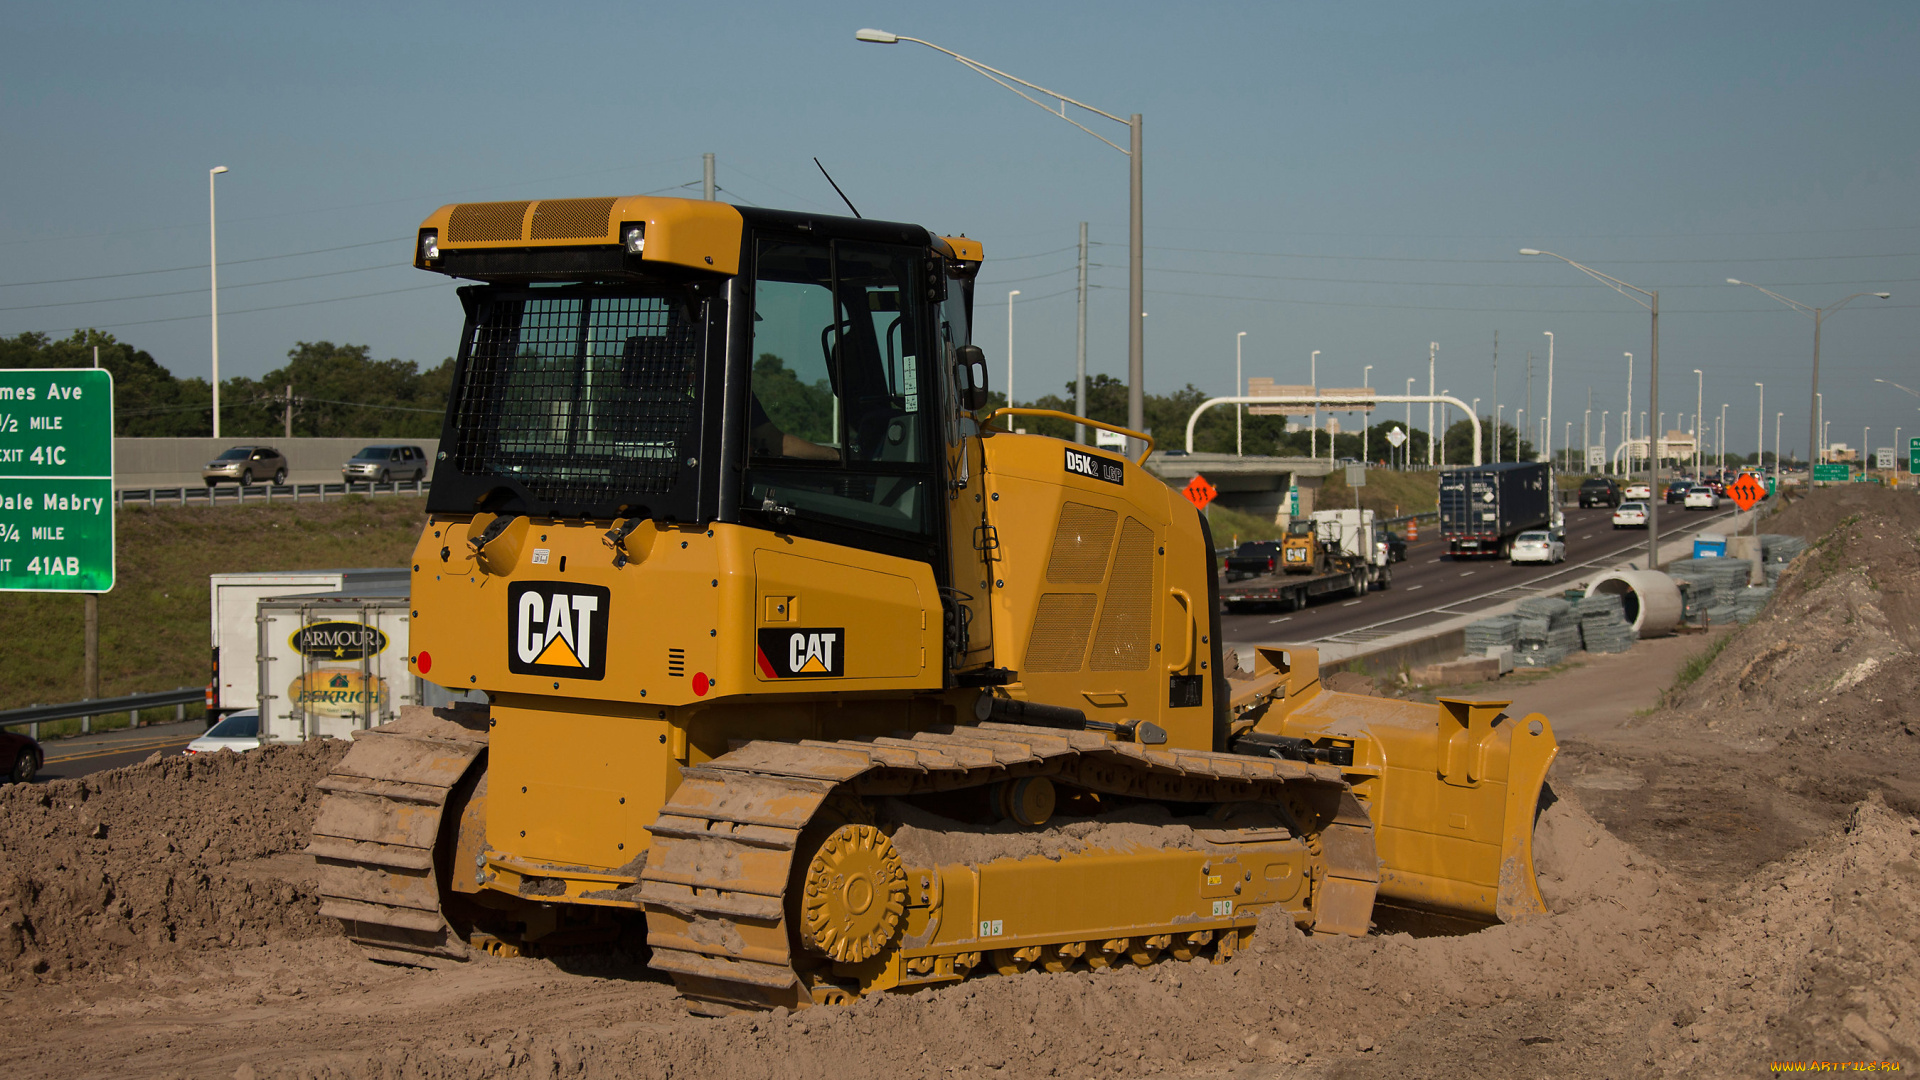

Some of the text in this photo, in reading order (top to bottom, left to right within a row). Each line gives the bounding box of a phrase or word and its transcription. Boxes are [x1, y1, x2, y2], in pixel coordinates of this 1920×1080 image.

[47, 383, 82, 400] Ave
[30, 416, 63, 430] MILE
[30, 446, 66, 466] 41C
[44, 493, 103, 515] Mabry
[0, 523, 65, 543] 3/4 MILE
[1287, 548, 1307, 562] CAT
[27, 556, 79, 576] 41AB
[302, 631, 376, 646] ARMOUR
[517, 590, 598, 668] CAT
[789, 632, 836, 673] CAT
[296, 690, 380, 706] ECKRICH
